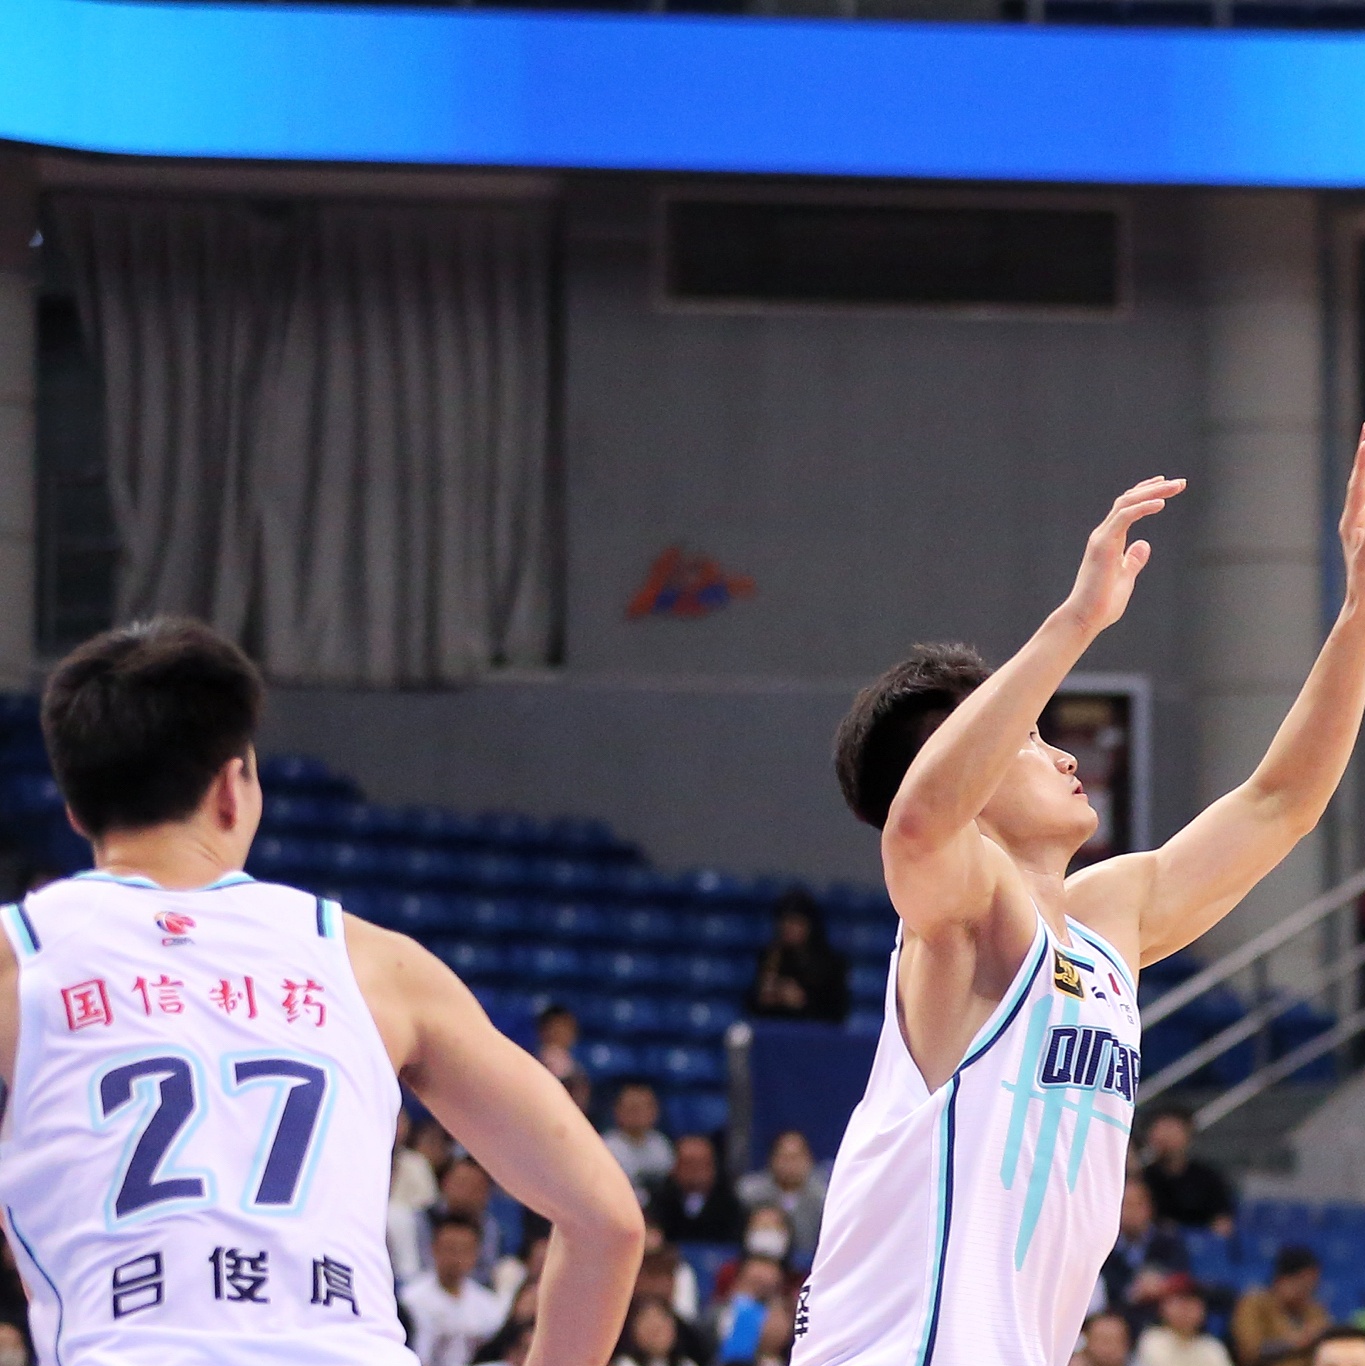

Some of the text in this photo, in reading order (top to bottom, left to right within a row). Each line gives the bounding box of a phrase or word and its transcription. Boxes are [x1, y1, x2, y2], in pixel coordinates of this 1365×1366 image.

[61, 973, 328, 1032] 国信制药
[94, 1050, 334, 1226] 27
[112, 1245, 363, 1321] 吕俊虎
